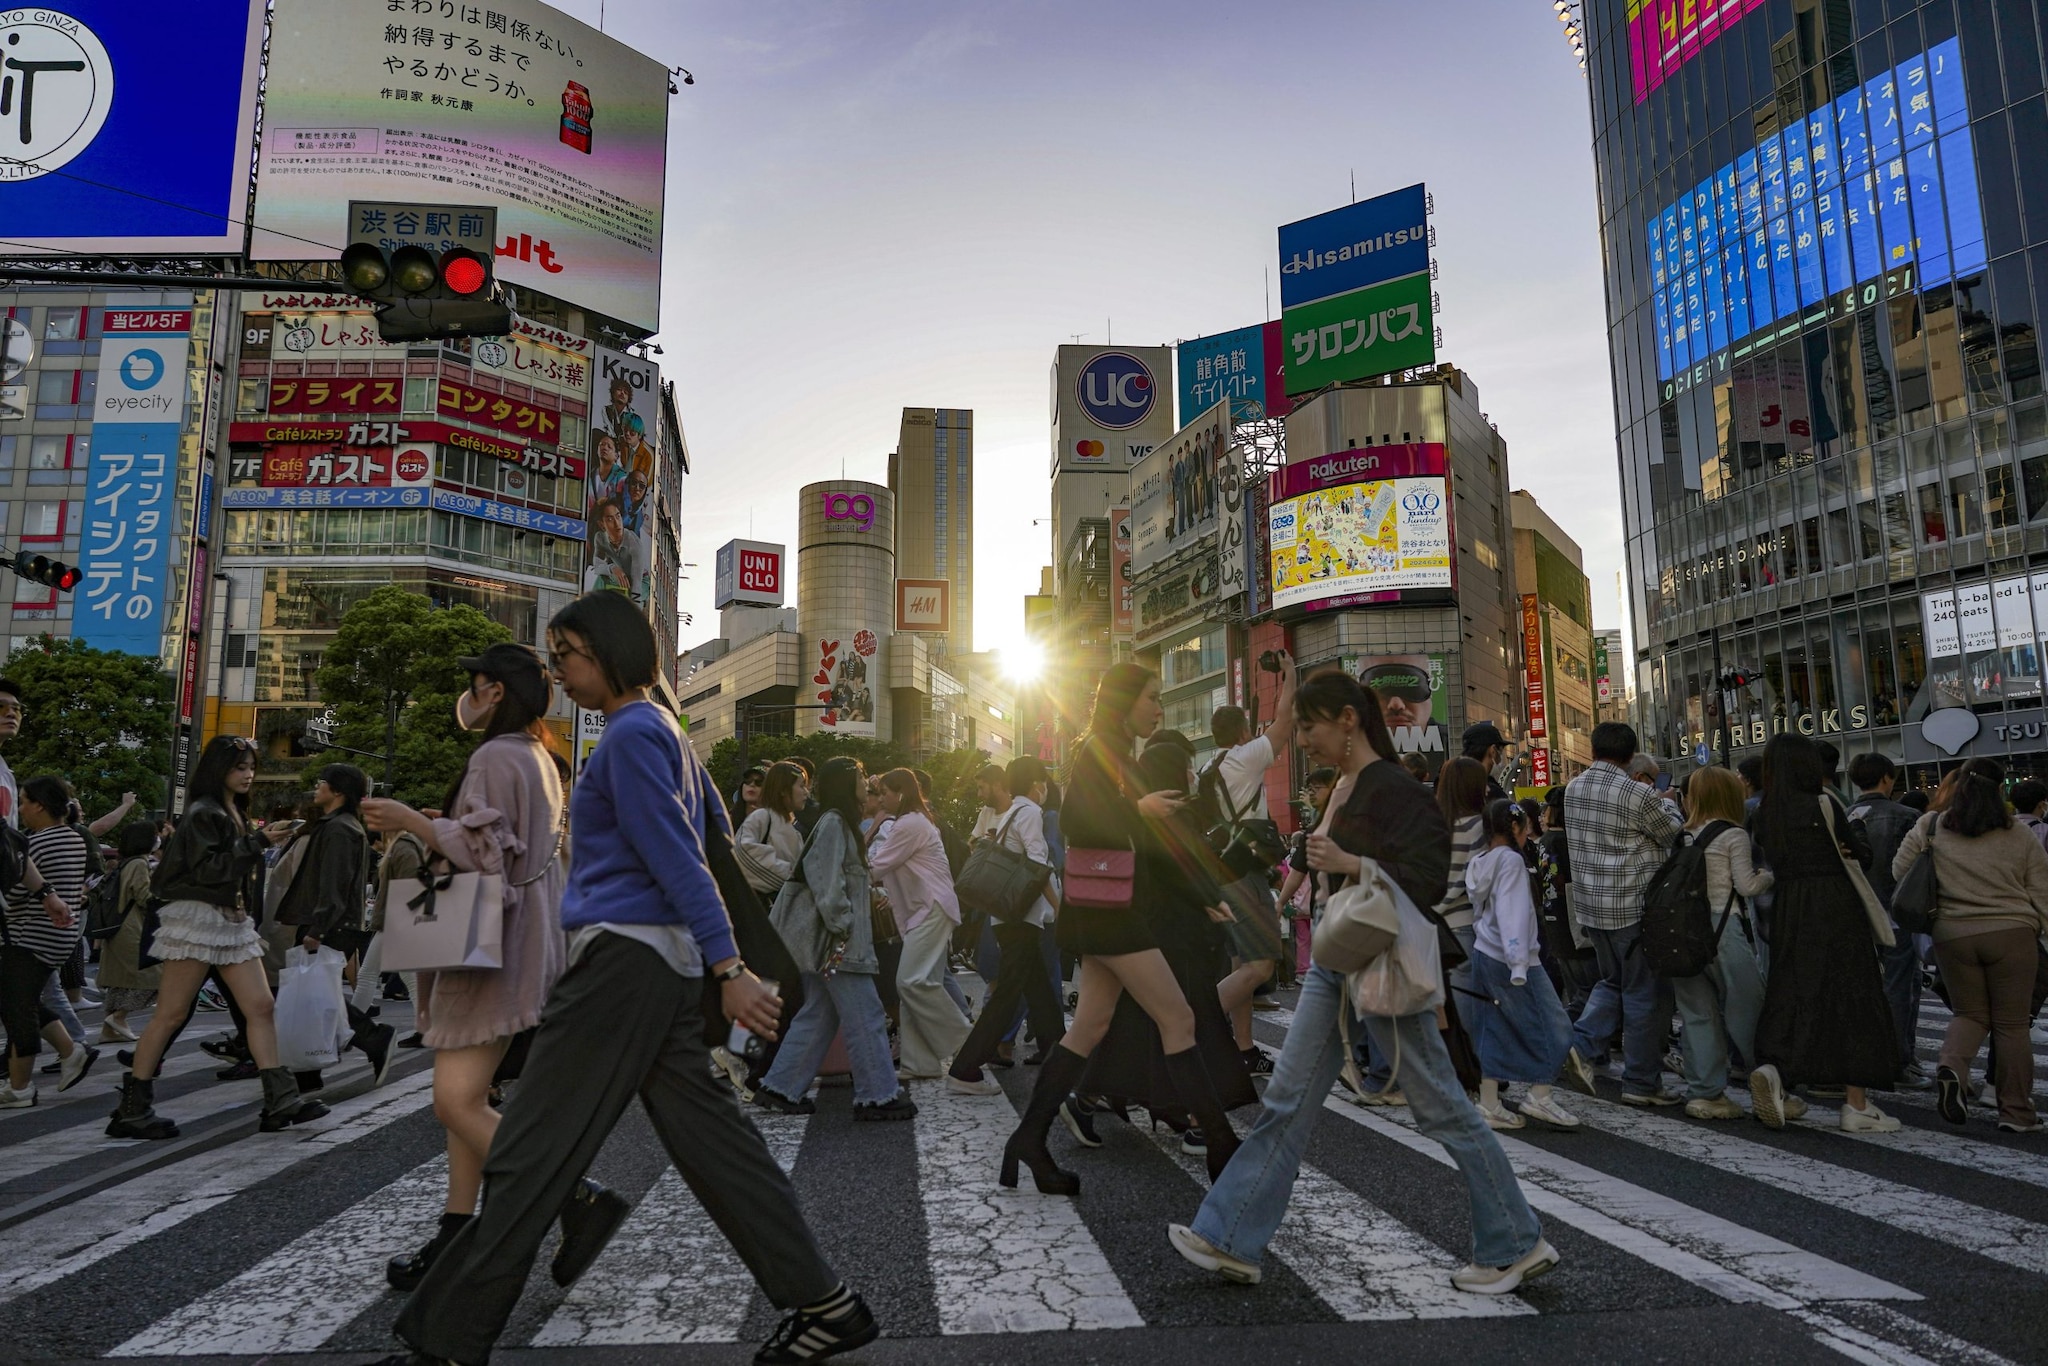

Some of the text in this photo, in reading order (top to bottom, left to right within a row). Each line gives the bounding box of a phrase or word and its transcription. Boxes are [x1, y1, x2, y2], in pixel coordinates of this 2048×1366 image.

[0, 11, 79, 36] YO GINZA
[387, 0, 583, 68] まわりは関係ない。
[384, 23, 530, 71] 納得するまで
[383, 55, 535, 107] やるかどうか。
[380, 88, 474, 112] 作詞家 秋元康
[360, 209, 484, 237] 渋谷駅前
[1282, 225, 1424, 275] Hisamitsu
[112, 313, 183, 329] 当ビル5F
[245, 329, 270, 345] 9F
[321, 323, 396, 346] しゃぶ
[1292, 303, 1423, 366] サロンパス
[514, 346, 584, 387] しゃぶ葉
[602, 355, 650, 393] Kroi
[1196, 348, 1246, 381] 龍角散
[273, 382, 397, 406] プライス
[1086, 372, 1149, 408] UC
[1190, 374, 1256, 406] ダイレクト
[105, 394, 172, 413] eyecity
[439, 384, 555, 434] コンタクト
[347, 422, 409, 445] ガスト
[232, 458, 262, 477] 7F
[269, 457, 303, 472] Café
[306, 453, 385, 485] ガスト
[400, 463, 425, 473] ガスト
[522, 448, 574, 477] ガスト
[1309, 455, 1380, 480] Rakuten
[269, 473, 302, 481] レストラン
[230, 490, 267, 503] AEON
[280, 490, 420, 505] 英会話イーオン 6F
[440, 494, 476, 511] AEON
[484, 501, 584, 535] 英会話イーオン
[822, 492, 875, 533] 109
[1219, 454, 1244, 591] もんじゃ
[1273, 516, 1293, 529] まるごと
[1402, 516, 1442, 525] Sunday
[87, 453, 135, 620] アイシティ
[126, 453, 165, 620] コンタクトの
[1402, 539, 1447, 548] 渋谷おとなり
[744, 555, 772, 572] UNI
[1402, 548, 1430, 557] サンデー
[744, 571, 774, 588] QLO
[910, 596, 935, 614] H&M
[1427, 659, 1444, 691] 再び
[1524, 597, 1545, 731] クスリのことなら 三千里
[584, 713, 606, 727] 6.19
